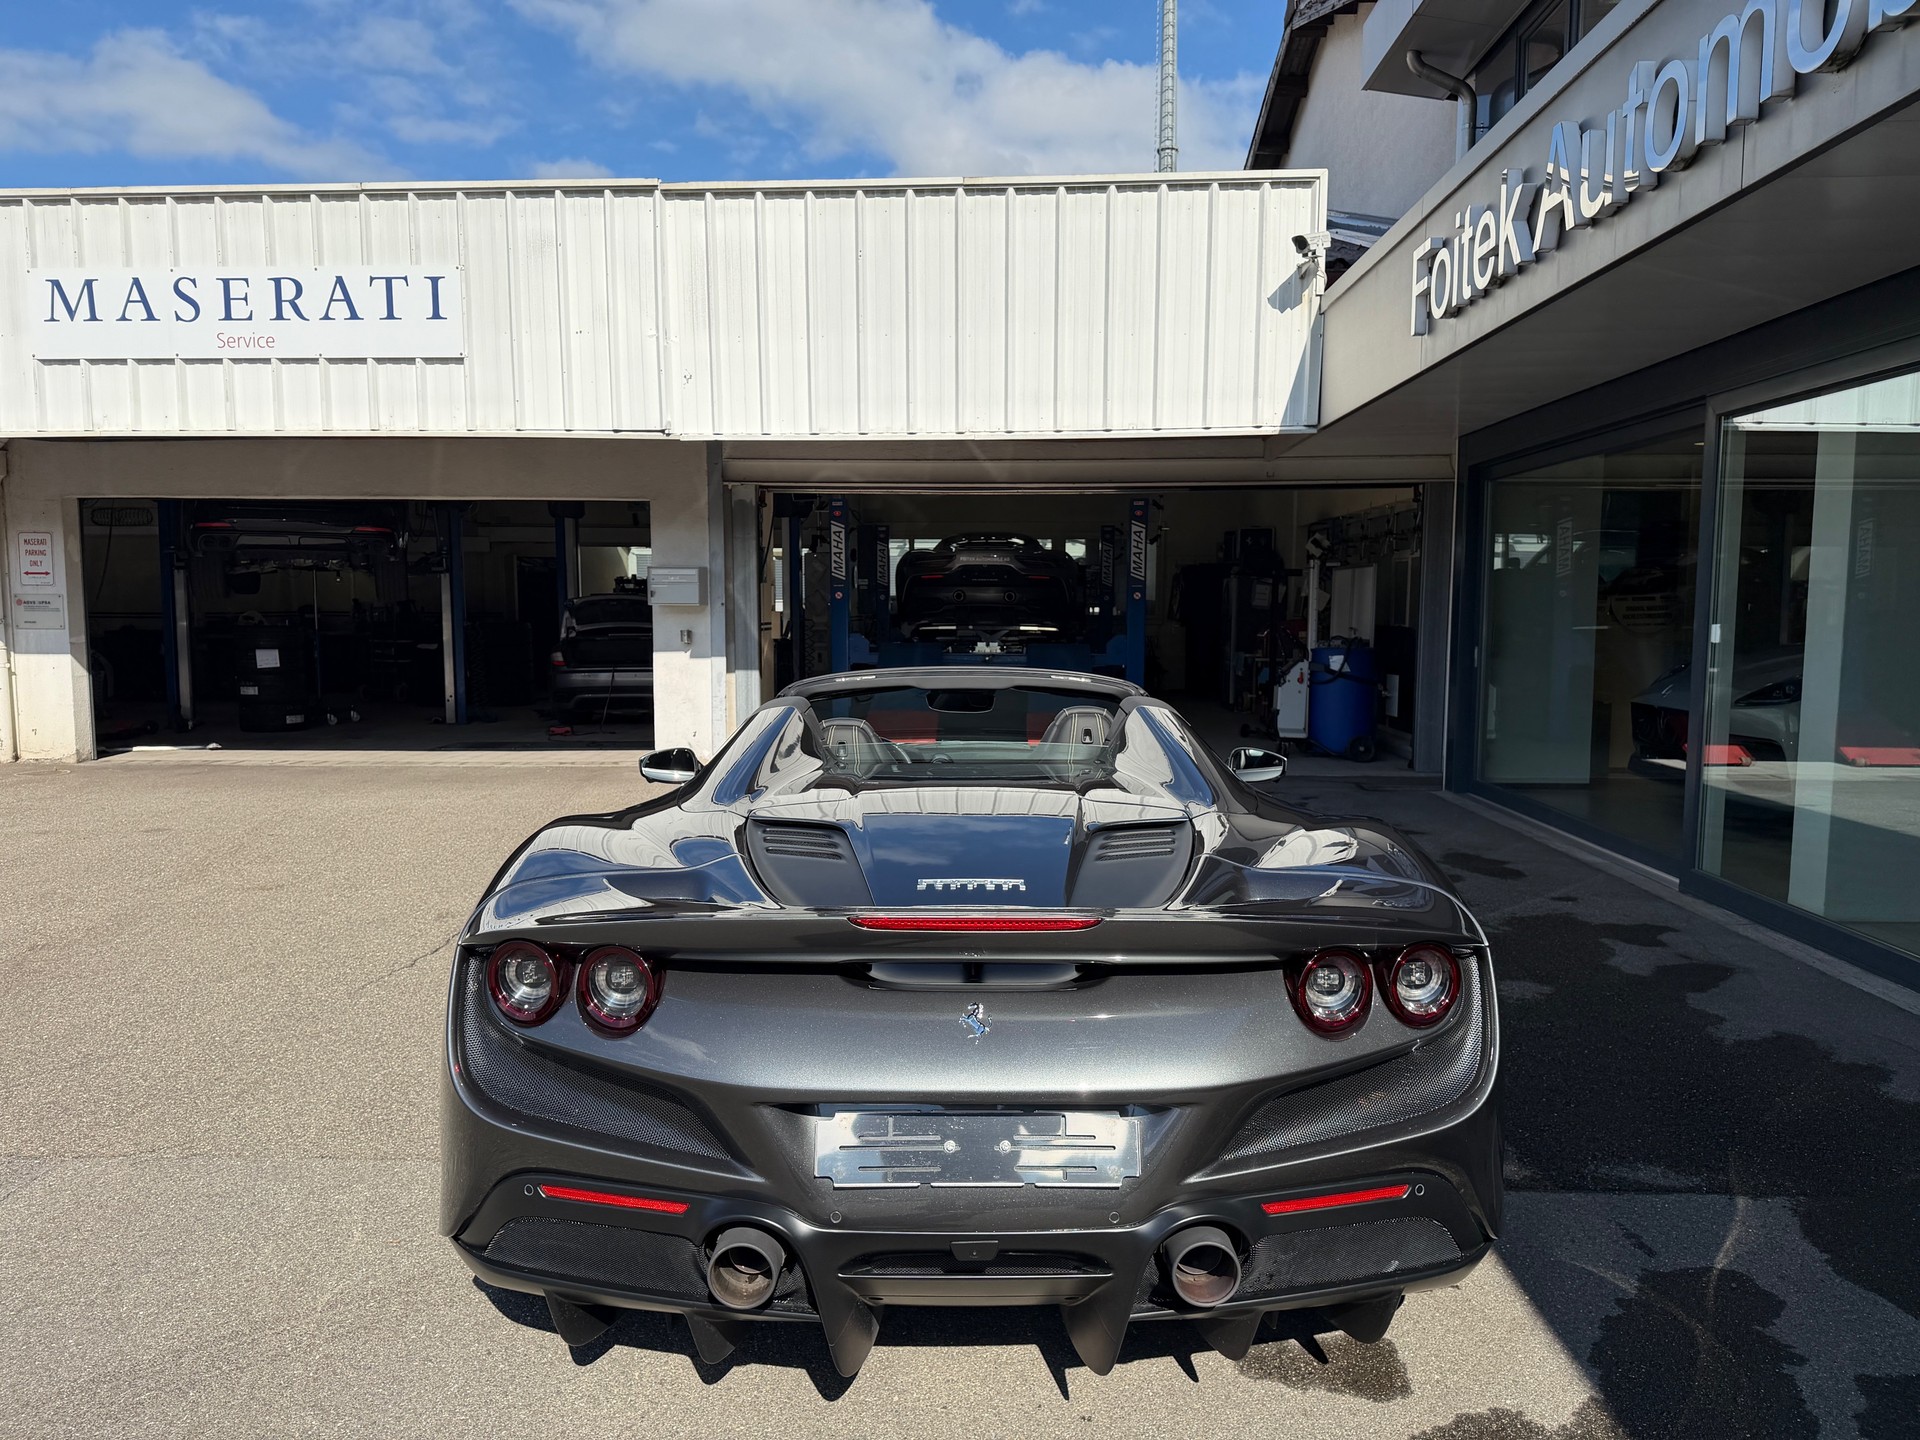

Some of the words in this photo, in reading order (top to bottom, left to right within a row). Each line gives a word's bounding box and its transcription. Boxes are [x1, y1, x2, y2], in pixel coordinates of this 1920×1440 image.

[1411, 168, 1534, 336] Foitek
[1532, 0, 1918, 254] Automo
[44, 275, 448, 323] MASERATI
[216, 332, 276, 348] Service
[23, 538, 47, 546] MASERATI
[24, 549, 47, 557] PARKING
[831, 529, 845, 575] MAHA
[1131, 529, 1145, 575] MAHA
